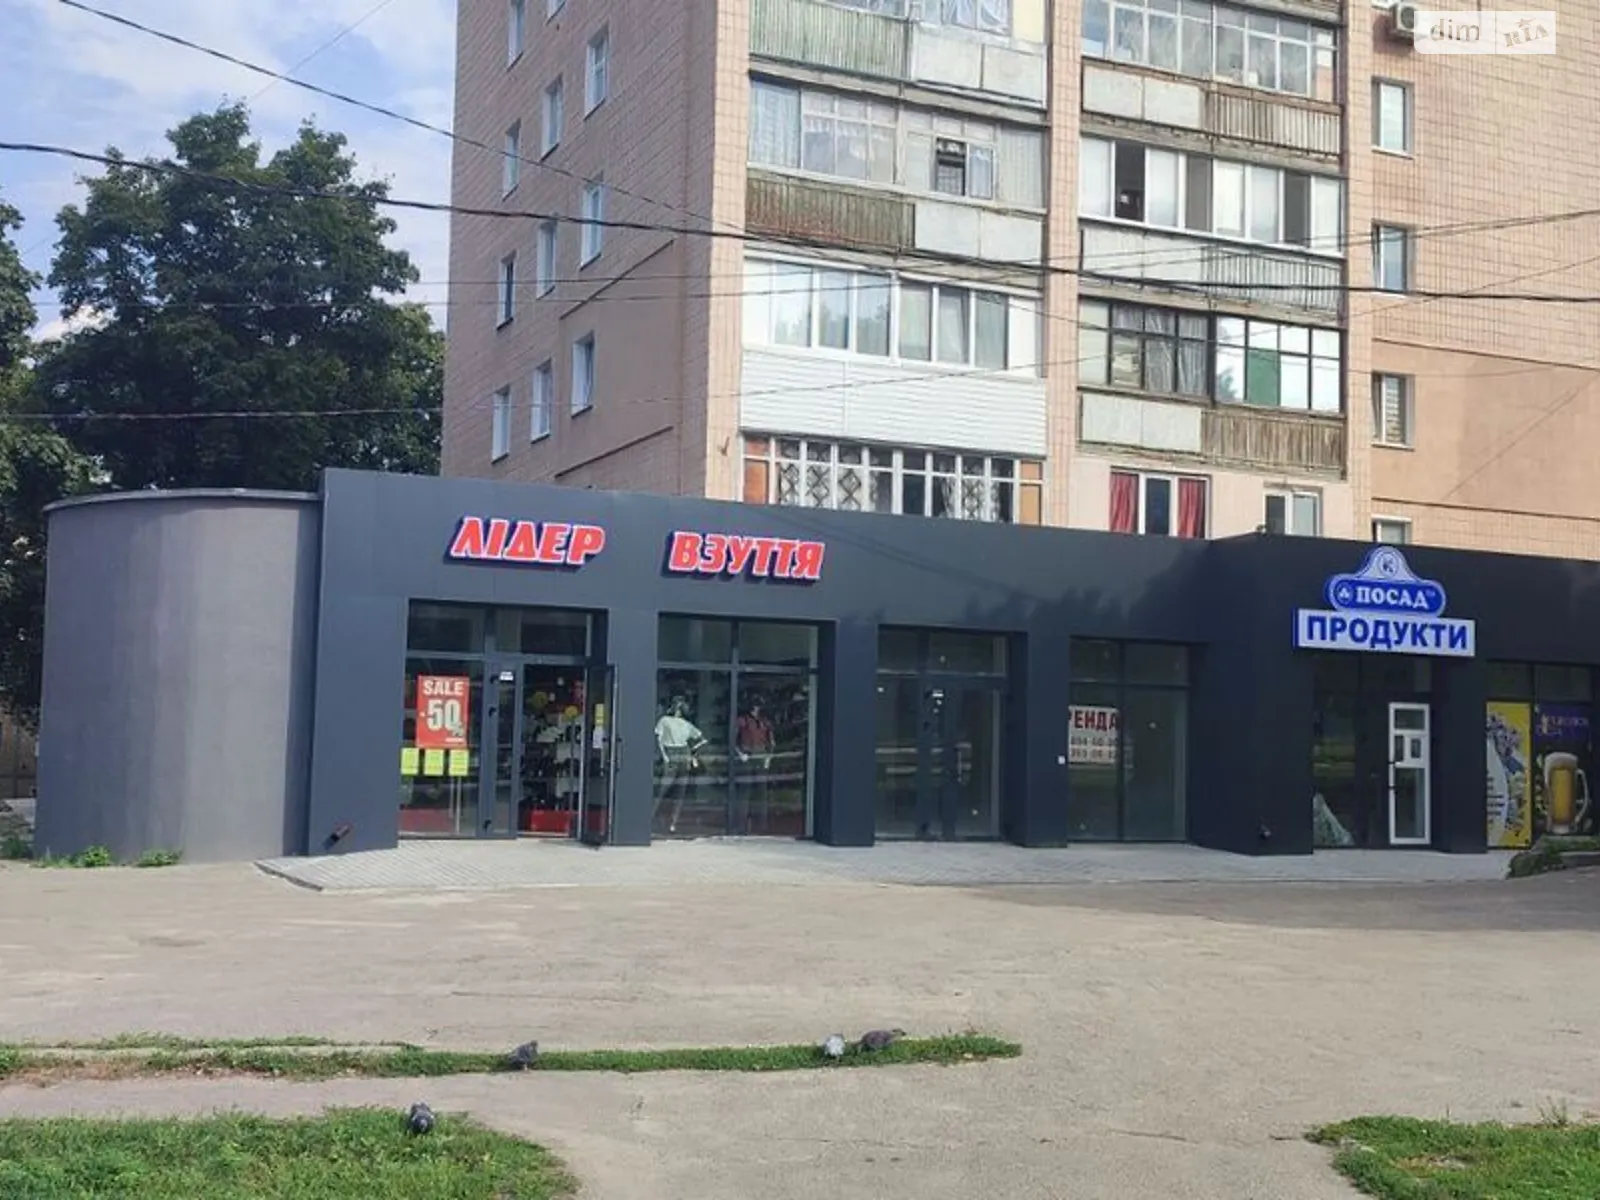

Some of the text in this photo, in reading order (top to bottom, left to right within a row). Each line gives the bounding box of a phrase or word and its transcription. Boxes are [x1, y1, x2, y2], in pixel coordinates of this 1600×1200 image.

[450, 515, 825, 581] ЛІДЕР ВЗУТТЯ
[1355, 586, 1429, 609] ПОСАД
[1307, 615, 1468, 650] ПРОДУКТИ
[423, 680, 464, 697] SALE
